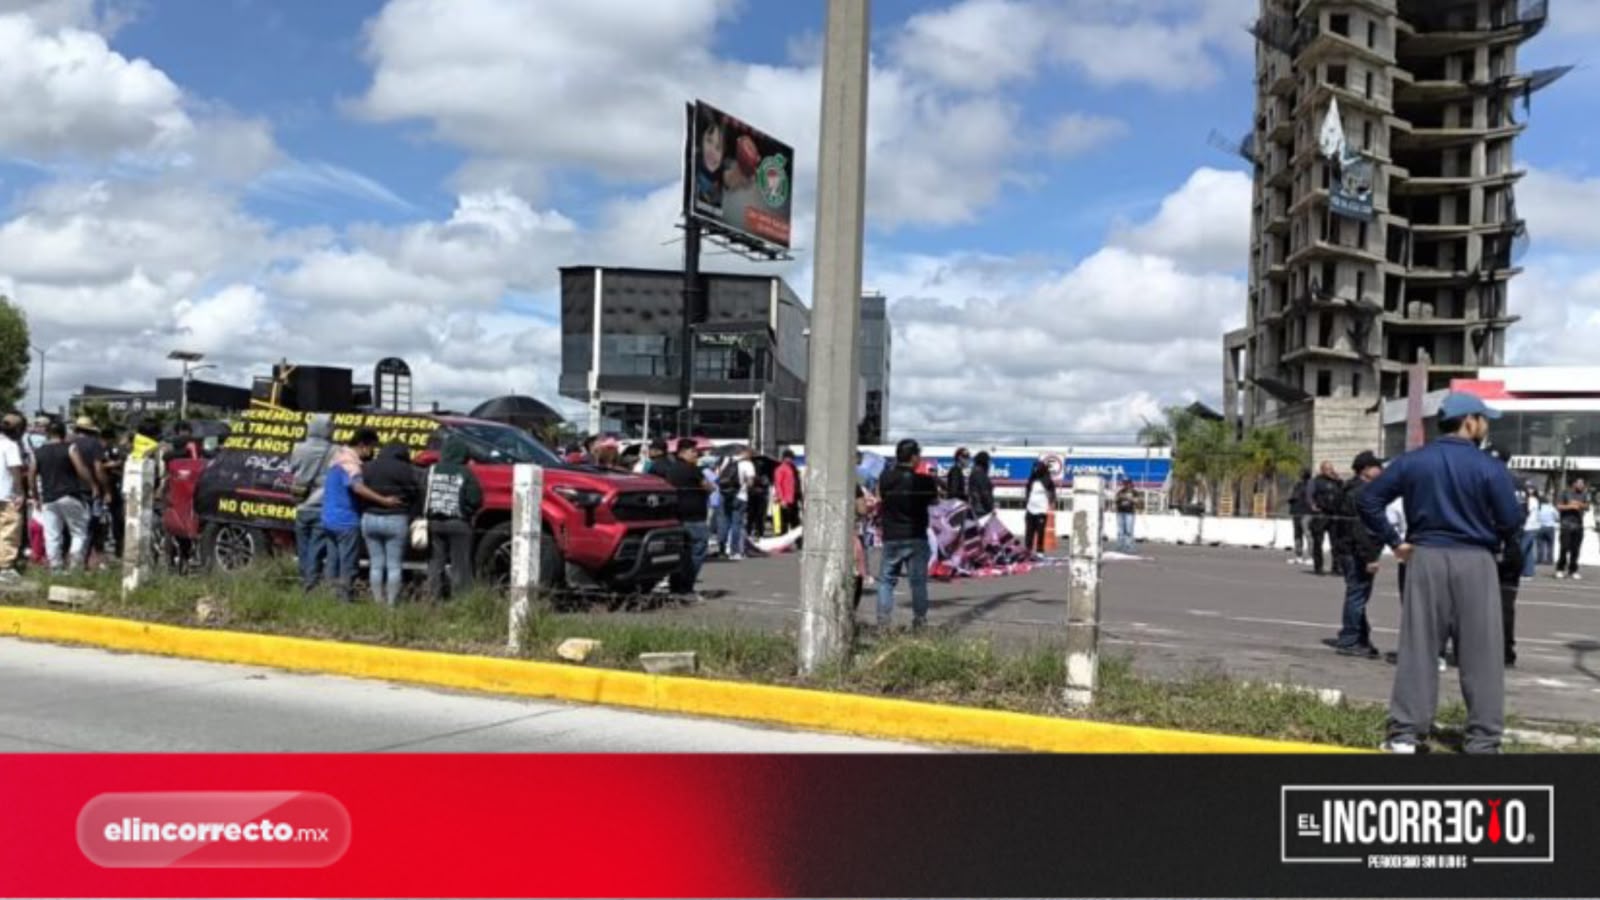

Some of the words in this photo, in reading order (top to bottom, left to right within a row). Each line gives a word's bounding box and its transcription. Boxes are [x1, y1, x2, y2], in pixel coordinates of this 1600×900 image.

[334, 414, 363, 426] NOS
[249, 423, 305, 438] TRABAJO
[408, 434, 429, 446] DE
[223, 436, 251, 449] DIEZ
[253, 437, 289, 453] AÑOS
[218, 499, 237, 512] NO
[241, 501, 297, 520] QUEREM
